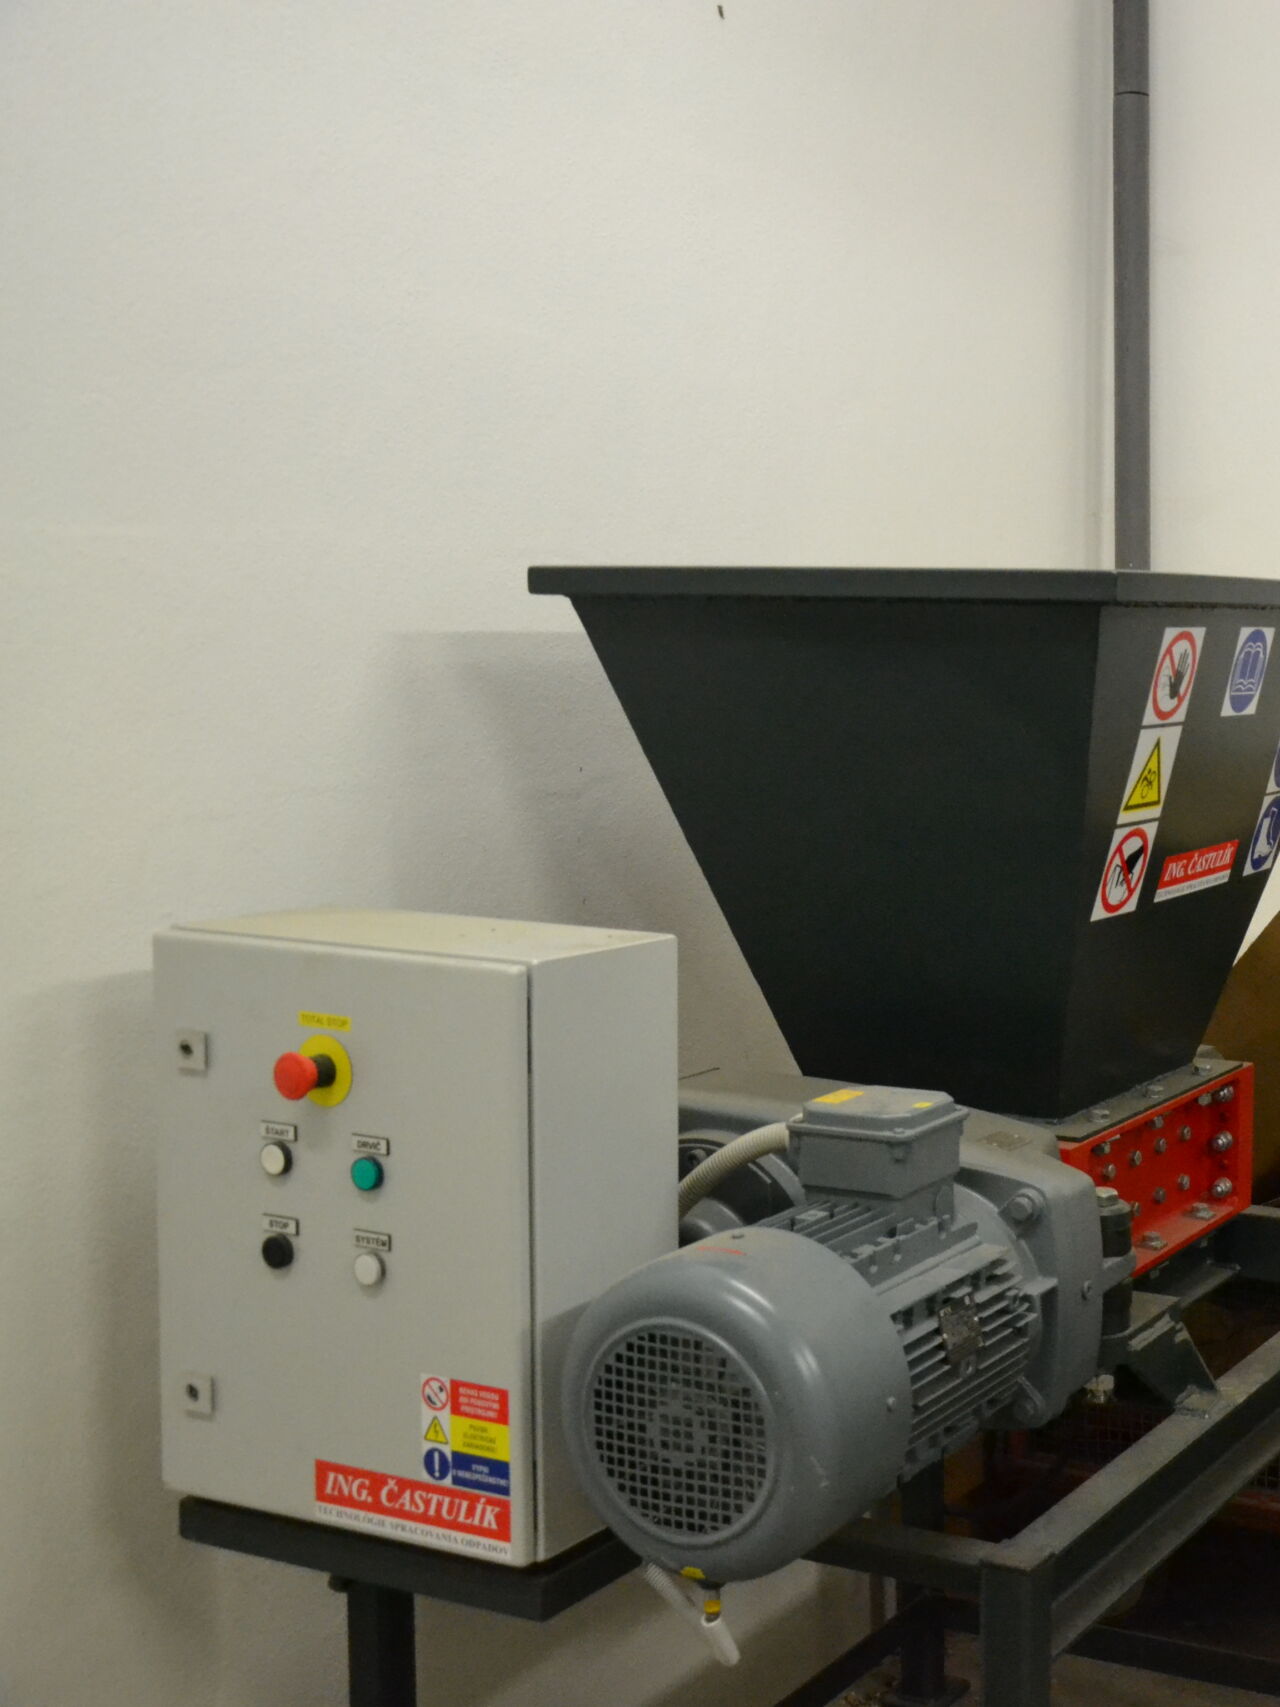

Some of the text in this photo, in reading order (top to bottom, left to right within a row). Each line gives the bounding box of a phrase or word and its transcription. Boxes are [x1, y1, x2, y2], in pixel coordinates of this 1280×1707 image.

[268, 1218, 289, 1230] STOP
[324, 1470, 502, 1530] ING. ČASTULÍK
